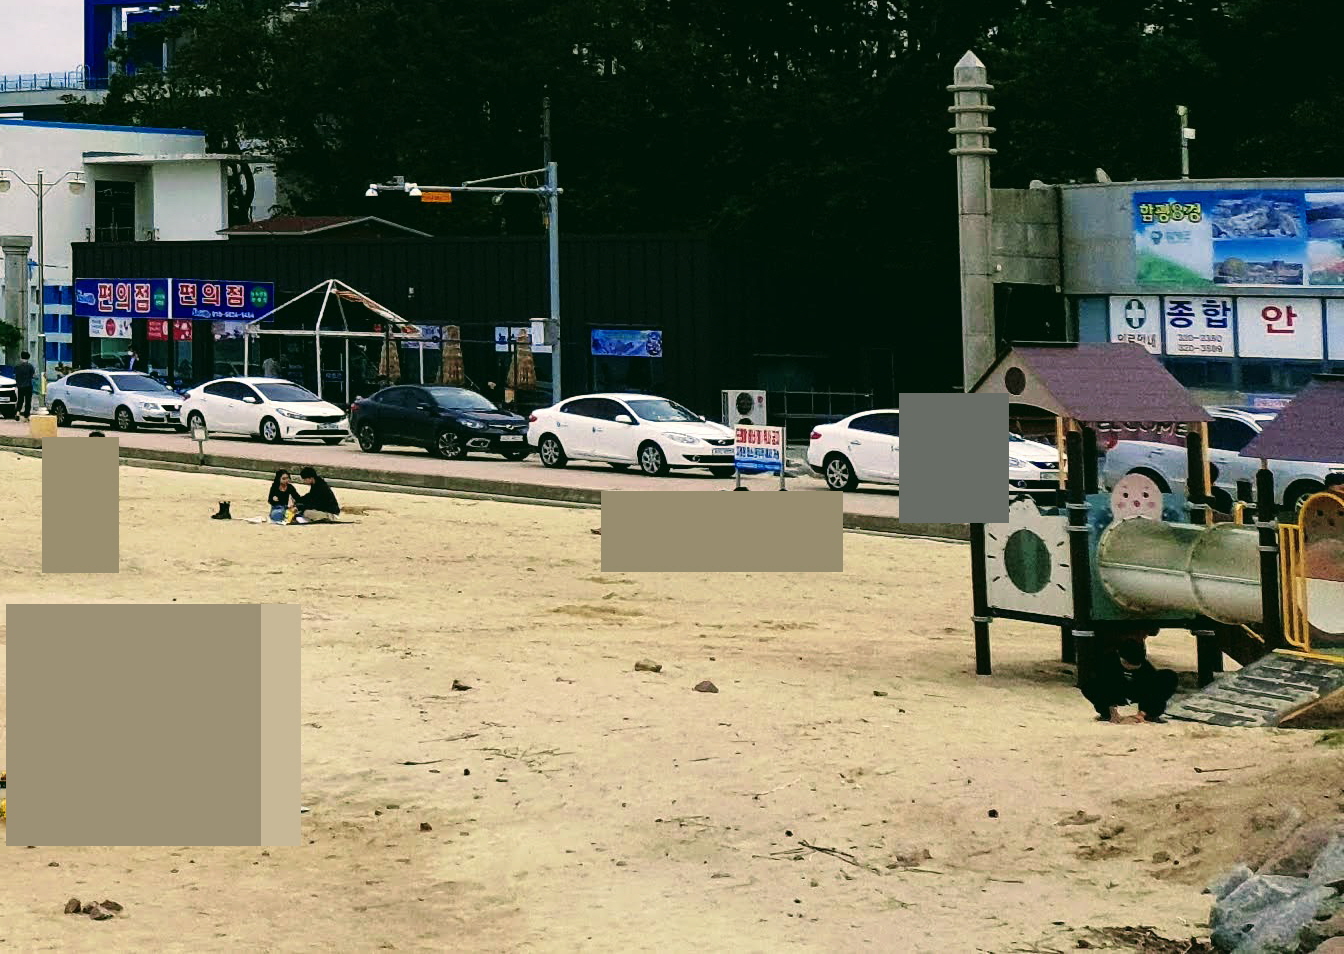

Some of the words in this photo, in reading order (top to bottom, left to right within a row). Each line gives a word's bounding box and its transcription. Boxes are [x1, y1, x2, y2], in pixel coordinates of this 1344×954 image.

[1139, 203, 1202, 223] 함평8경
[97, 283, 151, 313] 편의점
[178, 283, 245, 307] 편의점
[1166, 300, 1231, 329] 종합
[1261, 305, 1297, 334] 안
